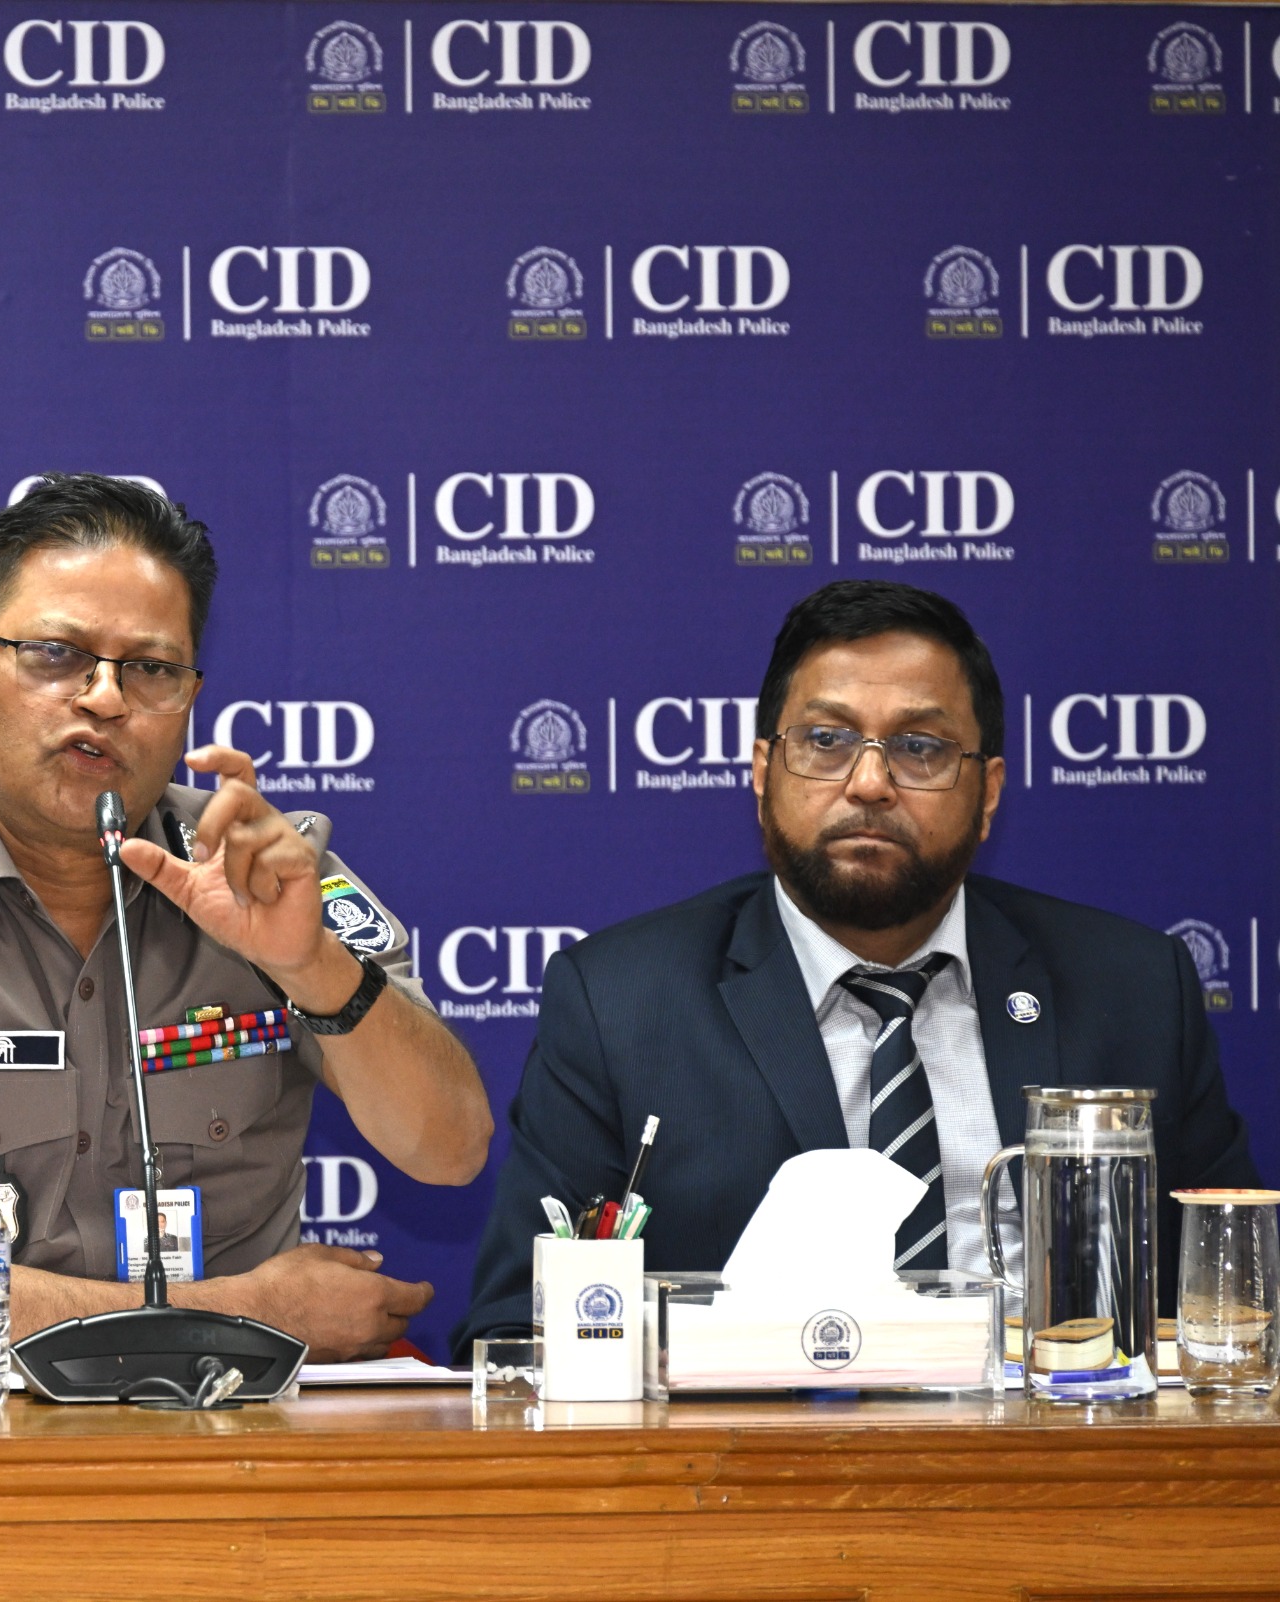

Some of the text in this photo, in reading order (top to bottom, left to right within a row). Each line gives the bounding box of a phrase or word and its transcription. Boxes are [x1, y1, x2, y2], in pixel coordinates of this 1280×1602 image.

[3, 19, 165, 87] CID
[431, 19, 591, 87] CID
[853, 20, 1011, 88] CID
[5, 92, 166, 114] Bangladesh Police
[432, 92, 592, 113] Bangladesh Police
[855, 92, 1011, 113] Bangladesh Police
[209, 245, 371, 314] CID
[631, 244, 790, 313] CID
[1046, 244, 1203, 312] CID
[211, 318, 371, 340] Bangladesh Police
[633, 317, 790, 339] Bangladesh Police
[1048, 316, 1203, 338] Bangladesh Police
[434, 472, 595, 541] CID
[857, 470, 1015, 538] CID
[436, 544, 595, 567] Bangladesh Police
[858, 542, 1015, 564] Bangladesh Police
[212, 700, 375, 768] CID
[1050, 693, 1207, 762] CID
[321, 773, 375, 792] Police
[636, 769, 737, 791] Bangladesh
[1052, 765, 1207, 787] Bangladesh Police
[439, 999, 540, 1022] Bangladesh
[325, 1228, 379, 1247] Police
